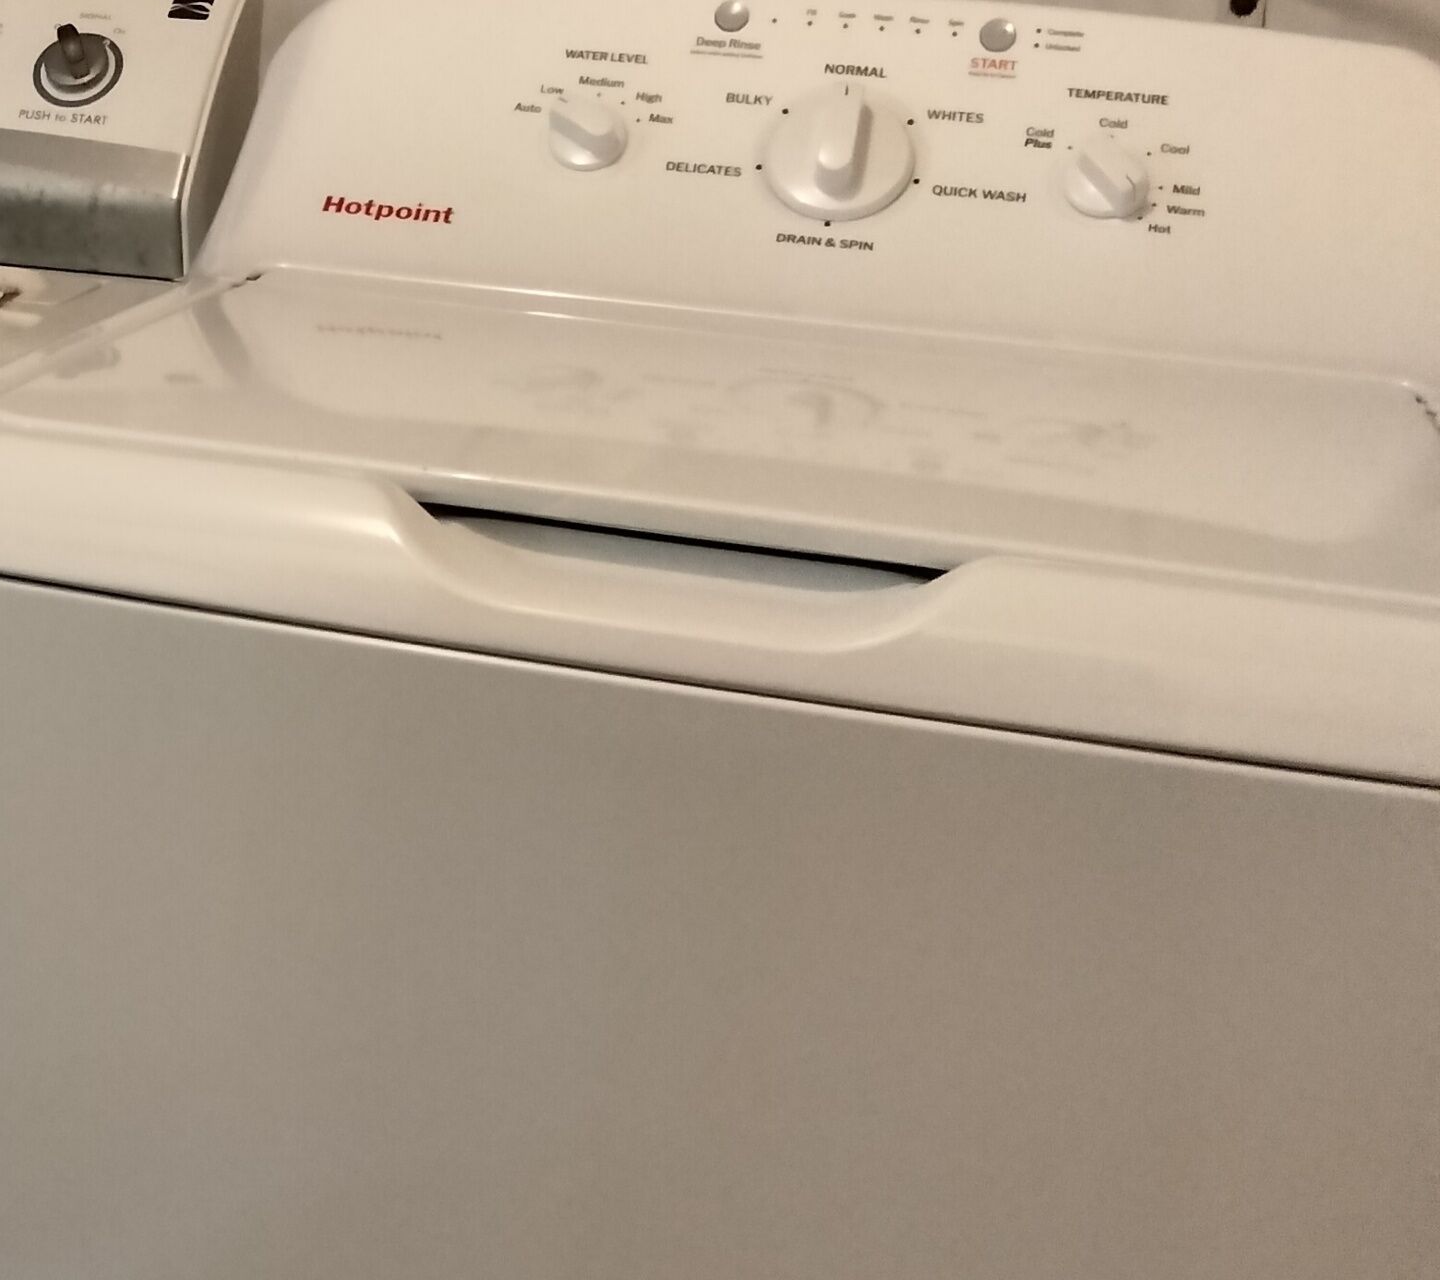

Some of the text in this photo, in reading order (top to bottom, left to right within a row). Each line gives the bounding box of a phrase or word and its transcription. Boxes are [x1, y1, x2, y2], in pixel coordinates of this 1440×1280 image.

[696, 35, 762, 51] Deep Rinse
[565, 48, 648, 65] WATER LEVEL
[970, 56, 1019, 71] START
[824, 62, 887, 79] NORMAL
[578, 75, 625, 89] Medium
[540, 84, 564, 96] Low
[1068, 87, 1169, 106] TEMPERATURE
[635, 91, 663, 105] High
[725, 92, 773, 107] BULKY
[514, 102, 542, 114] Auto
[18, 109, 109, 126] PUSH to START
[648, 113, 674, 125] Max
[927, 108, 984, 124] WHITES
[1099, 117, 1128, 130] Cold
[1025, 126, 1055, 139] Cold
[1024, 138, 1053, 150] Plus
[1160, 142, 1190, 155] Cool
[665, 160, 742, 178] DELICATES
[931, 184, 1027, 203] QUICK WASH
[1172, 183, 1201, 197] Mild
[322, 195, 455, 224] Hotpoint
[1166, 205, 1205, 218] Warm
[1148, 224, 1171, 235] Hot
[775, 232, 874, 252] DRAIN & SPIN
